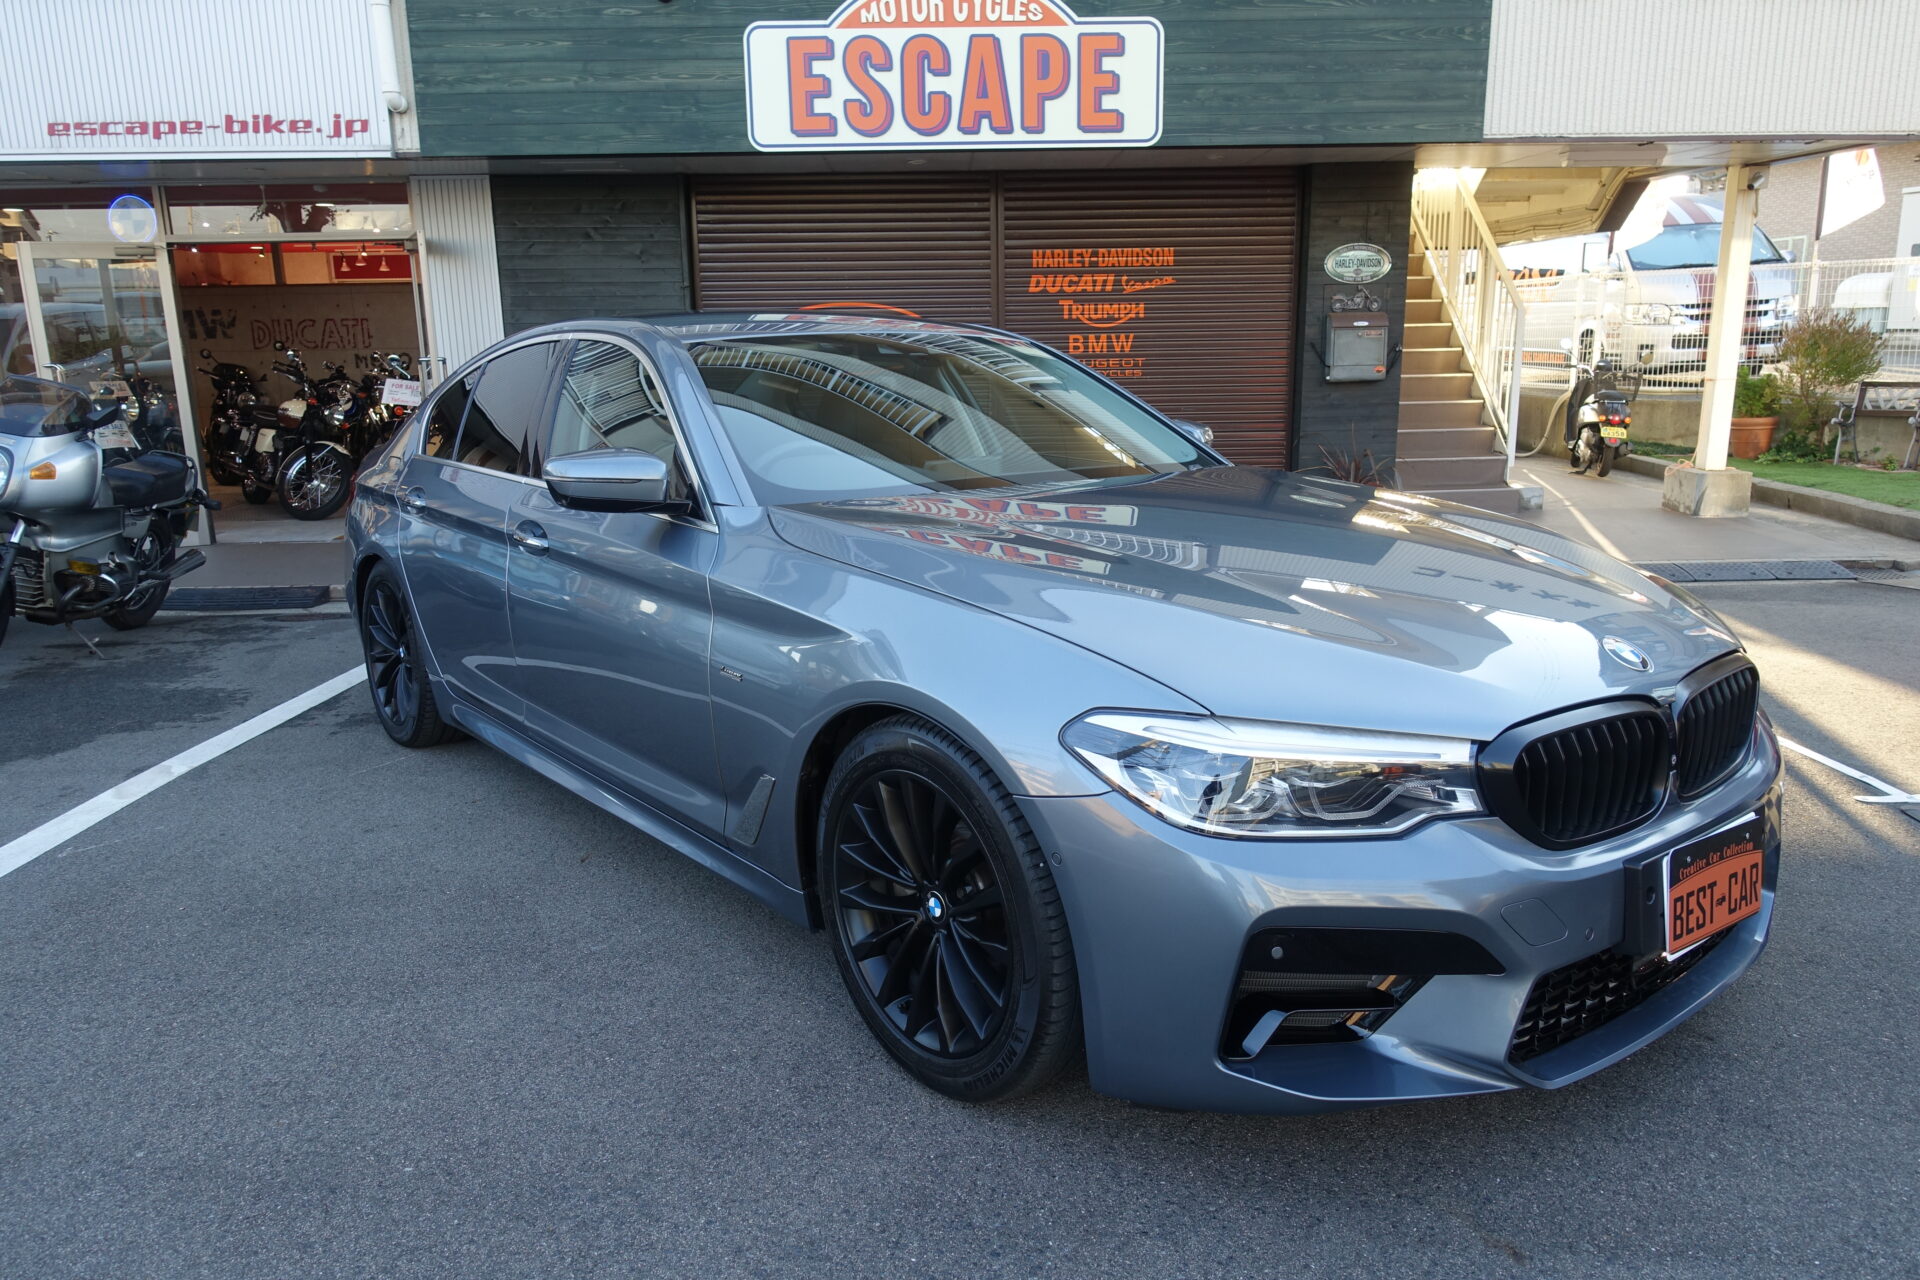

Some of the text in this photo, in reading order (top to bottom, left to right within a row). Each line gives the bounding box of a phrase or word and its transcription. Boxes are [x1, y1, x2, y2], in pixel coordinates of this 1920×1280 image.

[786, 32, 1125, 137] ESCAPE
[47, 114, 369, 139] escape-bike.jp
[1032, 248, 1175, 267] HARLEY-DAVIDSON
[1028, 273, 1115, 293] DUCATI
[1059, 300, 1145, 328] TRIUMPH
[250, 318, 373, 350] DUCATI
[1068, 333, 1135, 354] BMW
[1679, 840, 1754, 881] Creative Car Collection
[1673, 862, 1759, 942] BEST CAR
